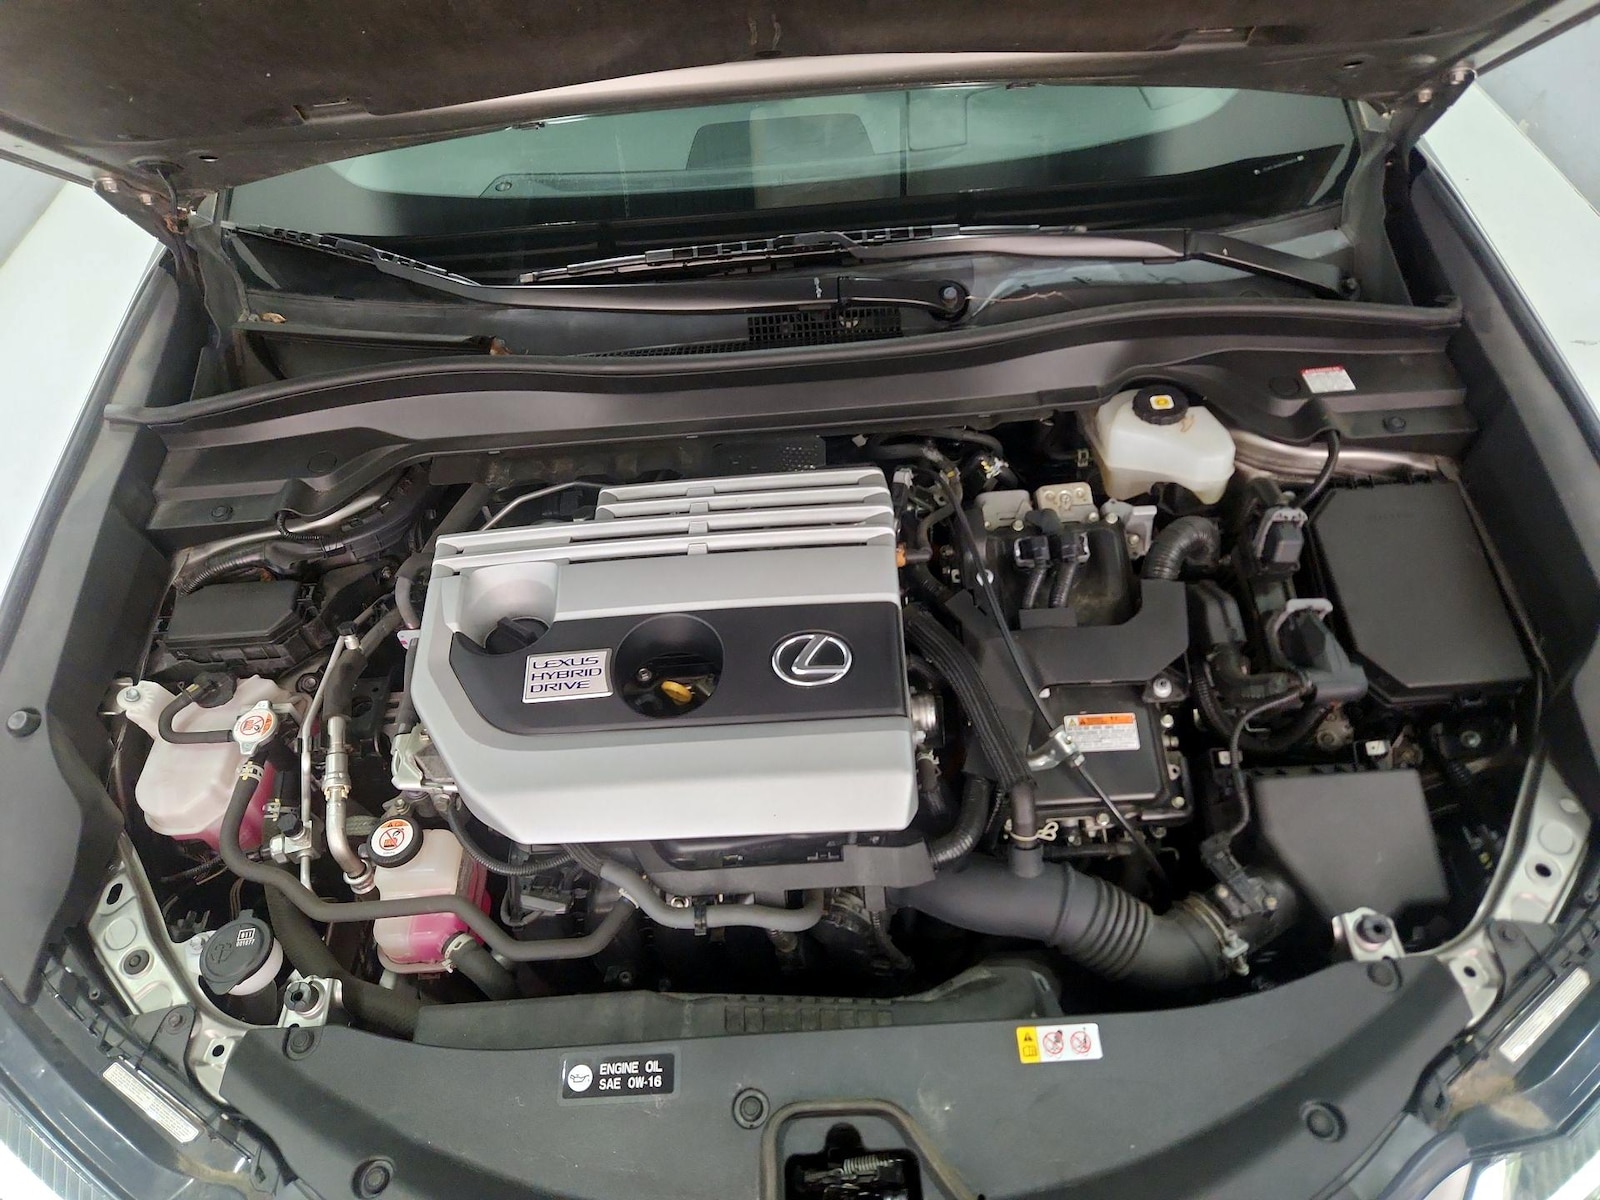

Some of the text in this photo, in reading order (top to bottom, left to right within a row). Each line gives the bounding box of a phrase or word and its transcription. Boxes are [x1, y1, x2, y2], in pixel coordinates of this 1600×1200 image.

[533, 655, 599, 669] LEXUS
[531, 668, 602, 681] HYBRID
[530, 680, 591, 693] DRIVE
[599, 1060, 663, 1075] ENGINE OIL
[598, 1075, 662, 1090] SAE 0W-16
